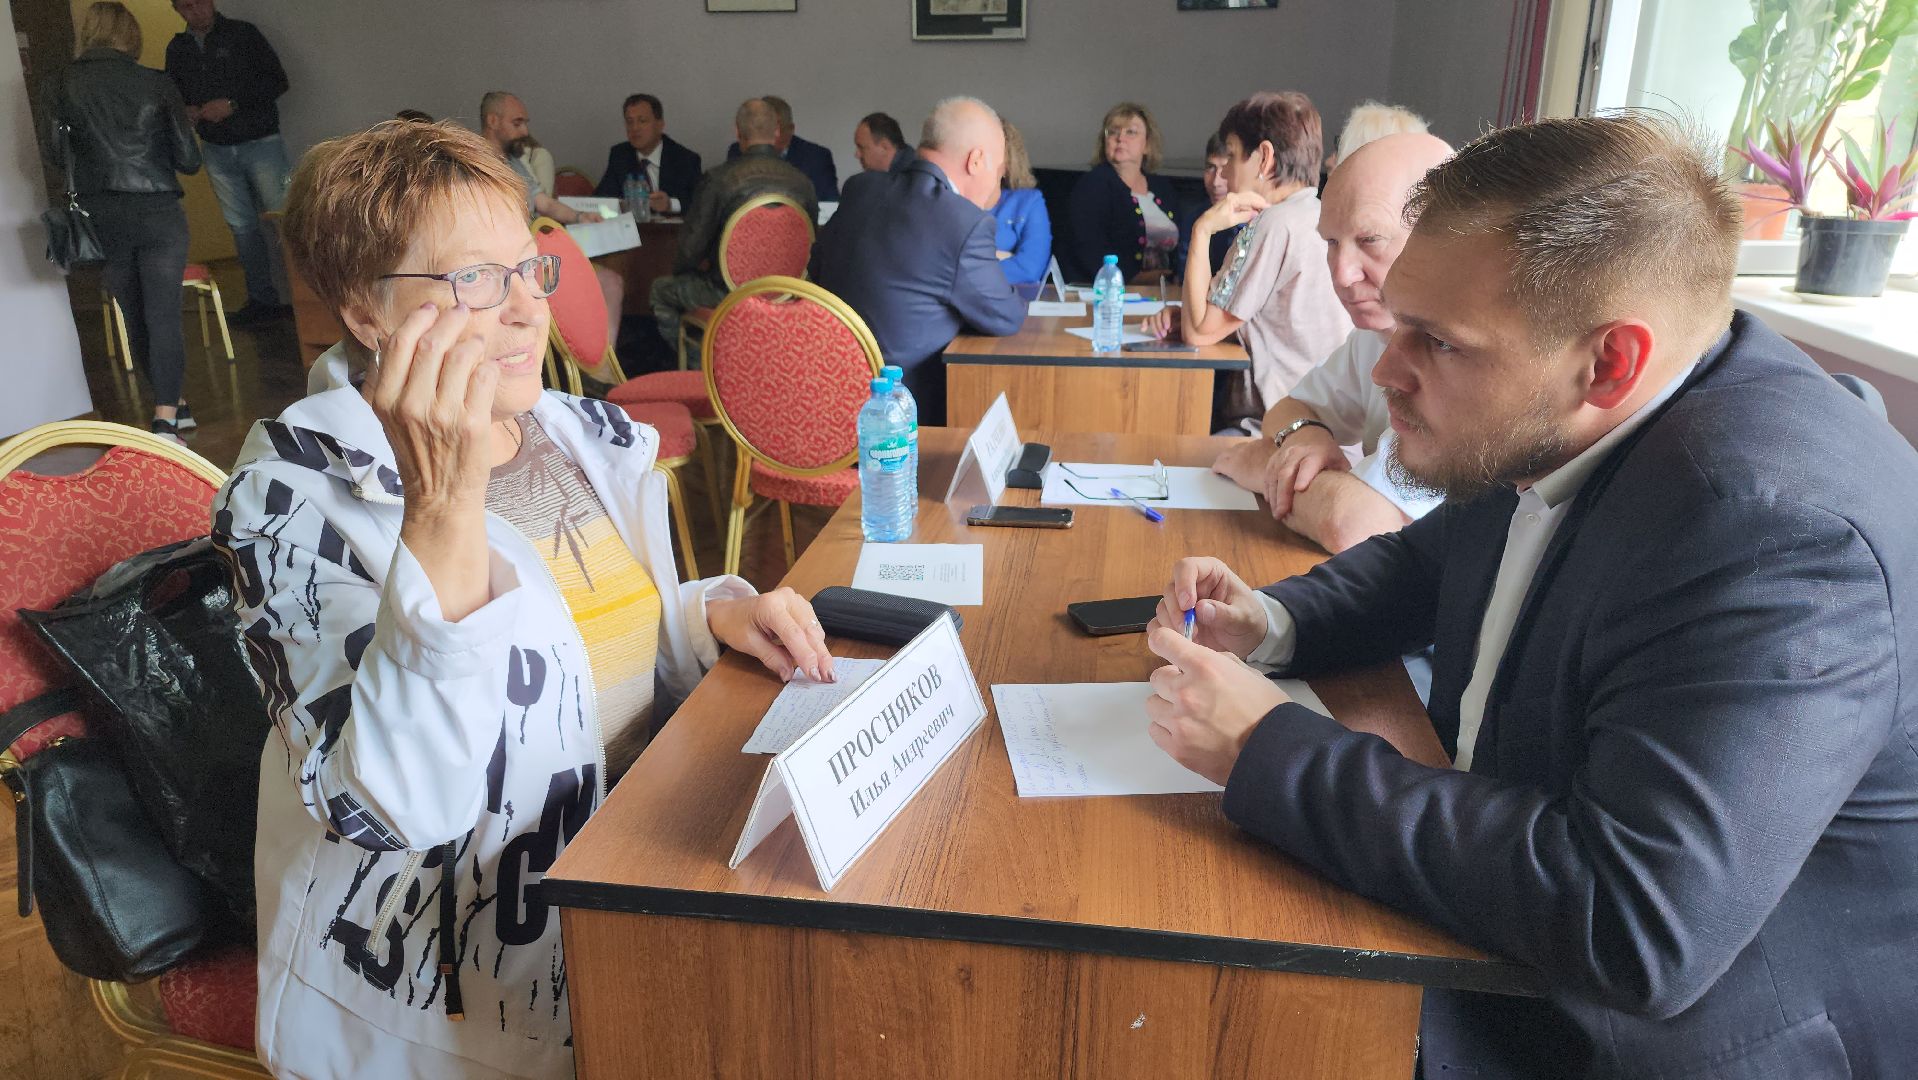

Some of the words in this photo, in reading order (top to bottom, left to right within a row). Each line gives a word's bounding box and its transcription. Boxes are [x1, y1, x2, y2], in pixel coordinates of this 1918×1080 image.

[827, 663, 943, 785] ПРОСНЯКОВ
[849, 771, 892, 819] Илья
[893, 704, 956, 778] Андреевич
